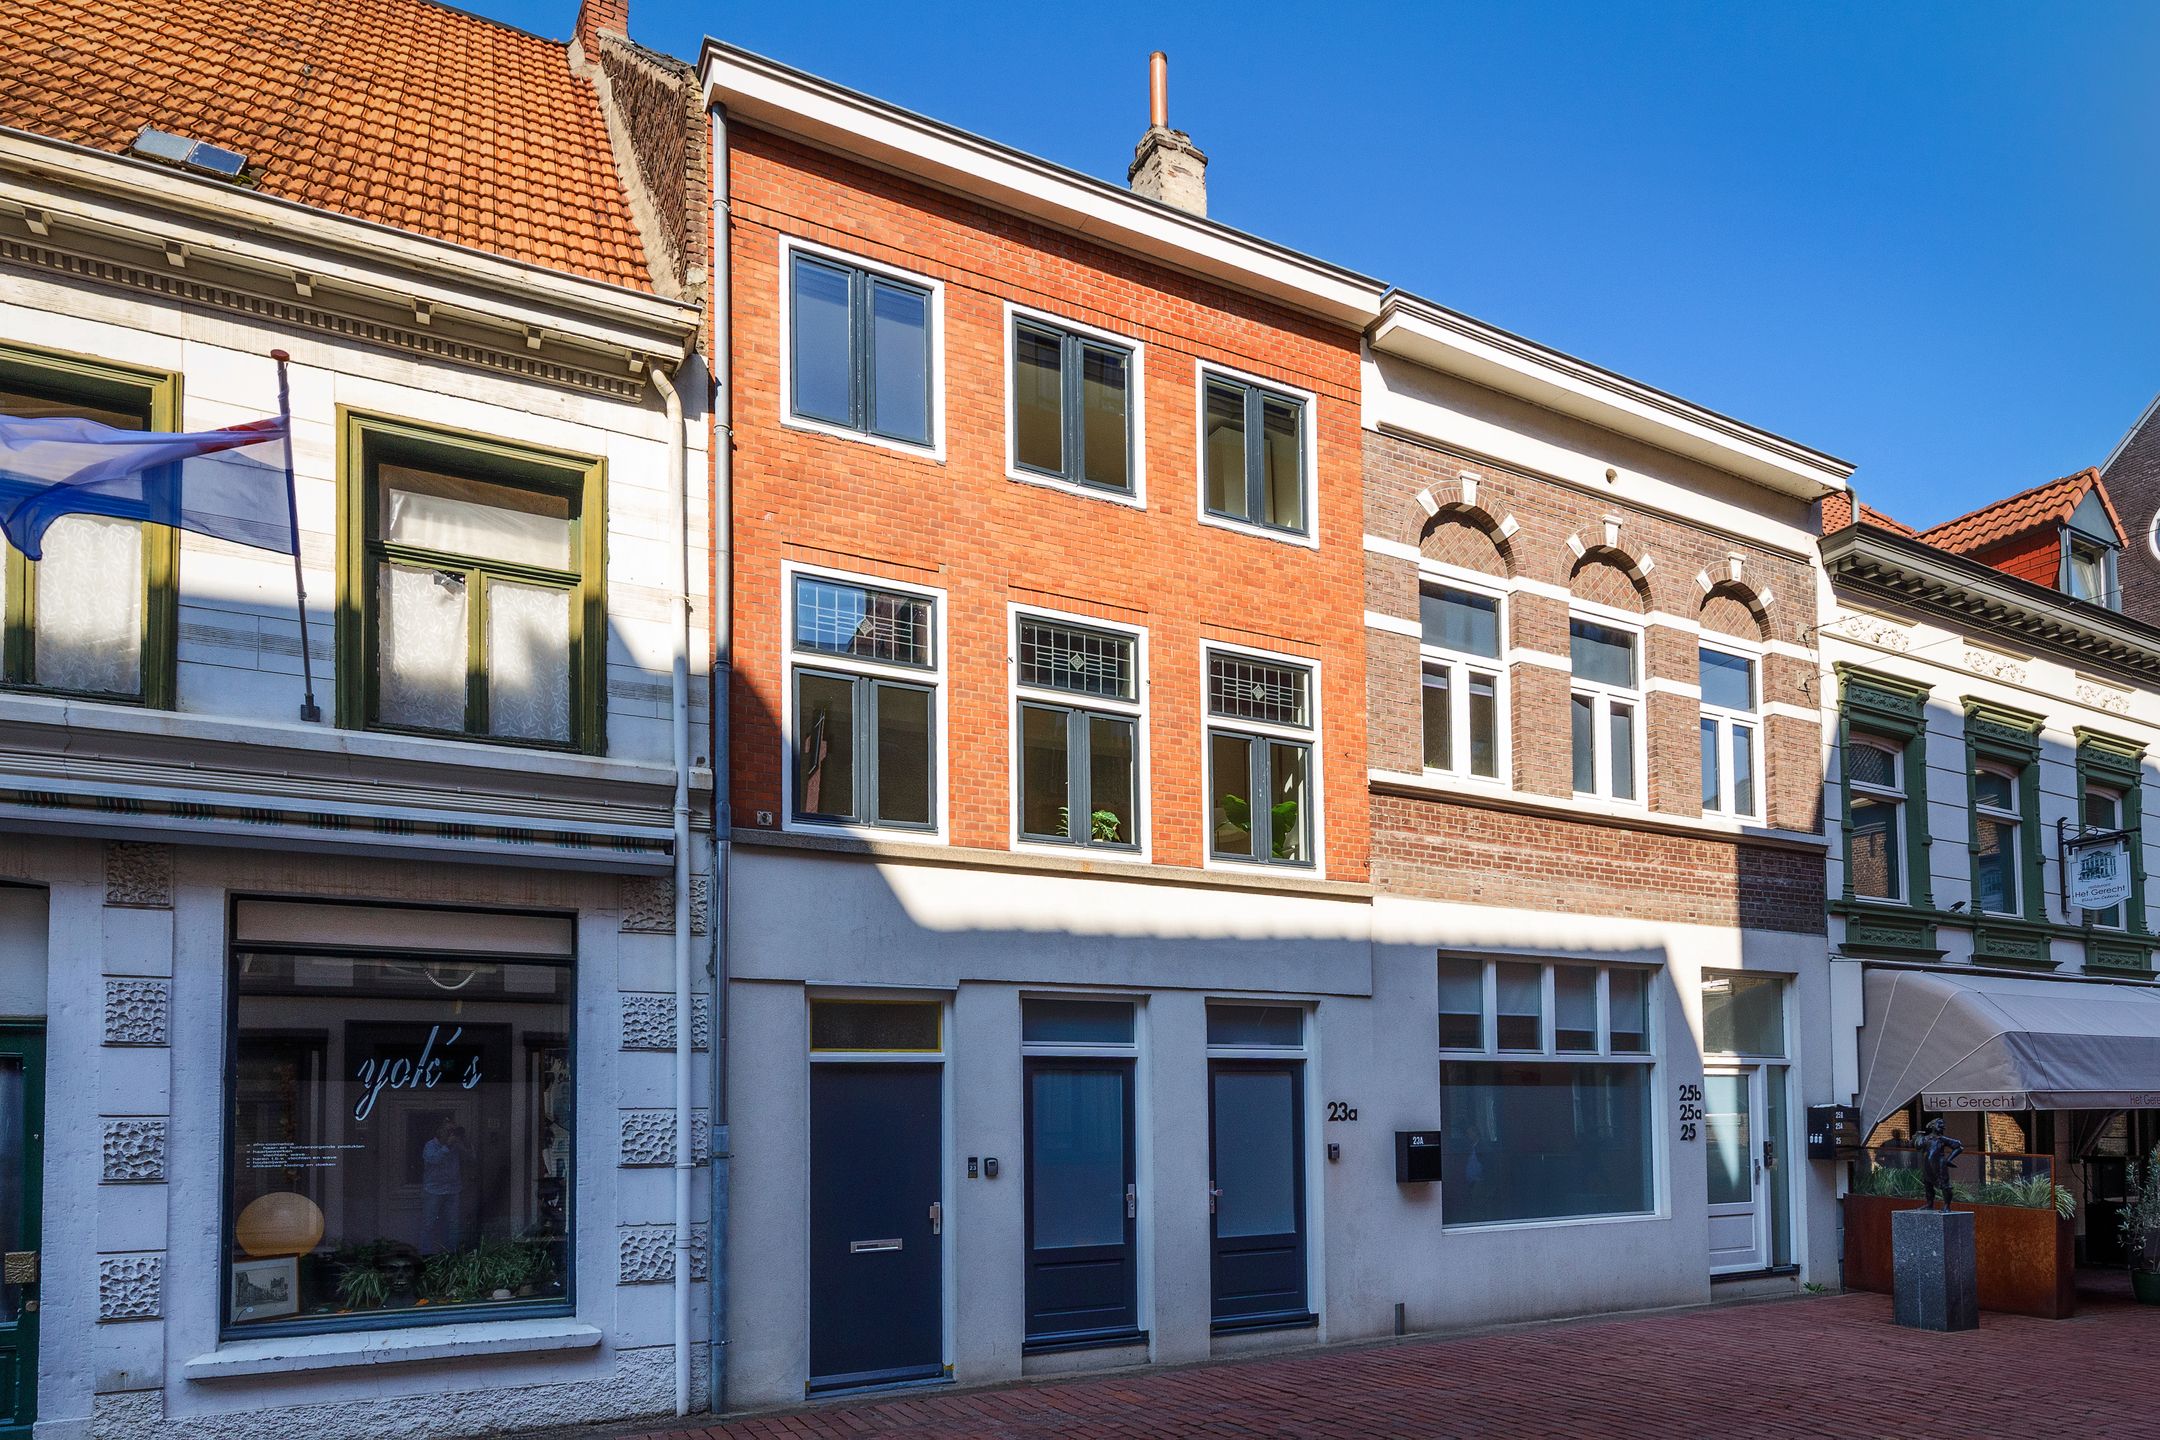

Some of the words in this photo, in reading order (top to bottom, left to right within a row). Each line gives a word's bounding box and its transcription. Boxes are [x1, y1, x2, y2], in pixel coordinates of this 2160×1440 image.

[2074, 890, 2089, 898] Het
[2090, 884, 2126, 896] Gerecht
[1679, 1084, 1702, 1101] 25b
[1929, 1096, 1953, 1108] Het
[1955, 1095, 2016, 1108] Gerecht
[1327, 1101, 1358, 1121] 23a
[1679, 1104, 1702, 1121] 25a
[1680, 1123, 1697, 1141] 25
[1412, 1136, 1424, 1145] 23A
[1835, 1136, 1842, 1145] 25
